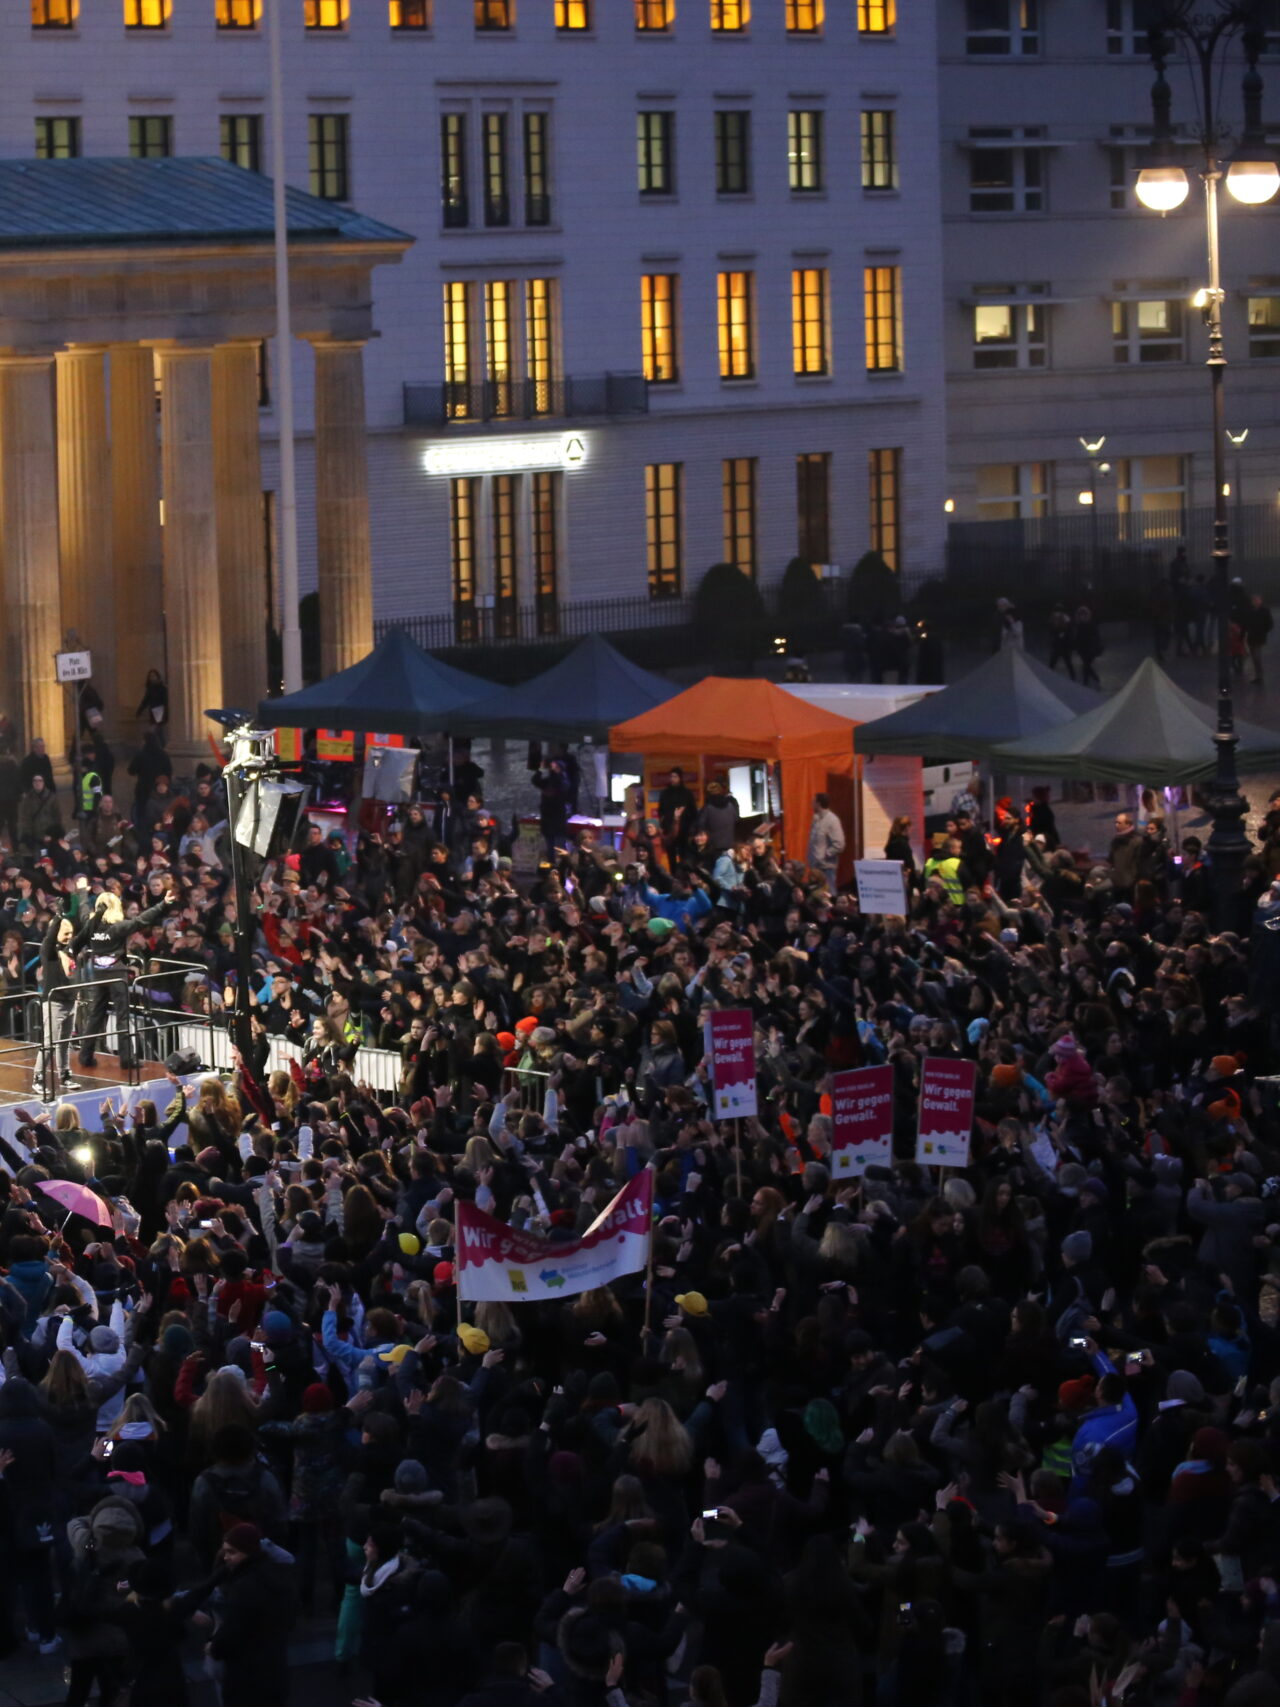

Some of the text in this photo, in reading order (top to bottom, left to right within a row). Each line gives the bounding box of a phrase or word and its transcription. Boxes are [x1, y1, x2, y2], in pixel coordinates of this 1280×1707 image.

[714, 1037, 752, 1051] Wir gegen
[714, 1050, 745, 1064] Gewalt.
[924, 1083, 972, 1100] Wir gegen
[835, 1093, 891, 1111] Wir gegen
[923, 1097, 960, 1112] Gewalt.
[834, 1108, 877, 1126] Gewalt.
[462, 1225, 498, 1249] Wir
[597, 1197, 649, 1232] walt.
